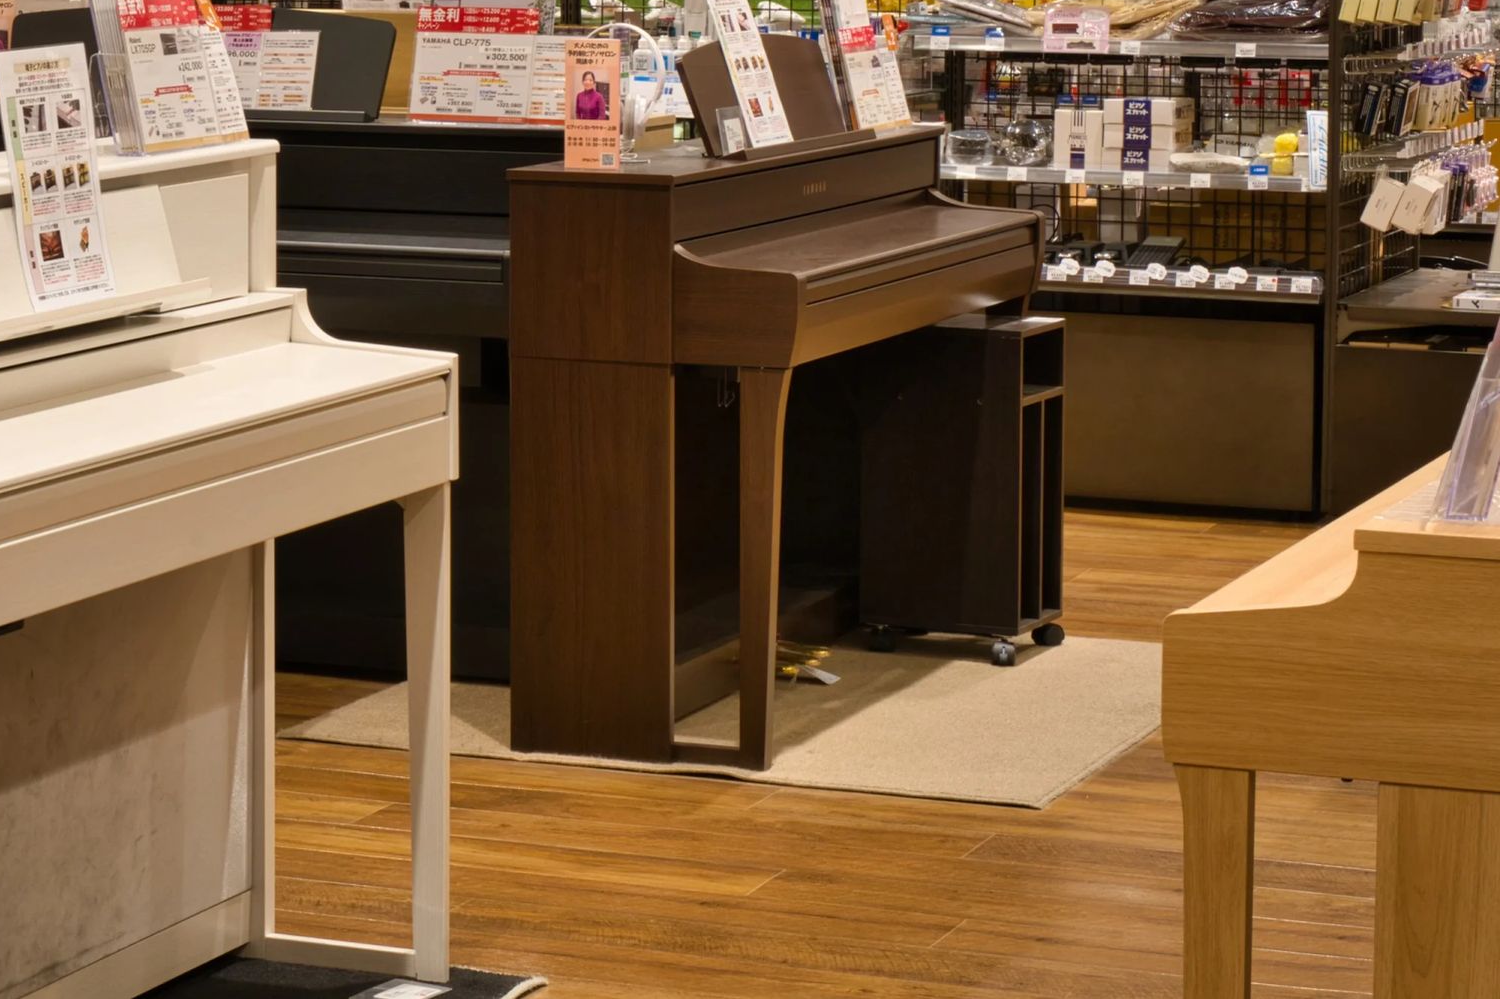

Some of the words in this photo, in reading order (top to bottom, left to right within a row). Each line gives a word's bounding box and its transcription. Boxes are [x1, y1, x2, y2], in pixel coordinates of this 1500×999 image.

[419, 7, 460, 23] 無金利
[452, 38, 492, 47] CLP-775
